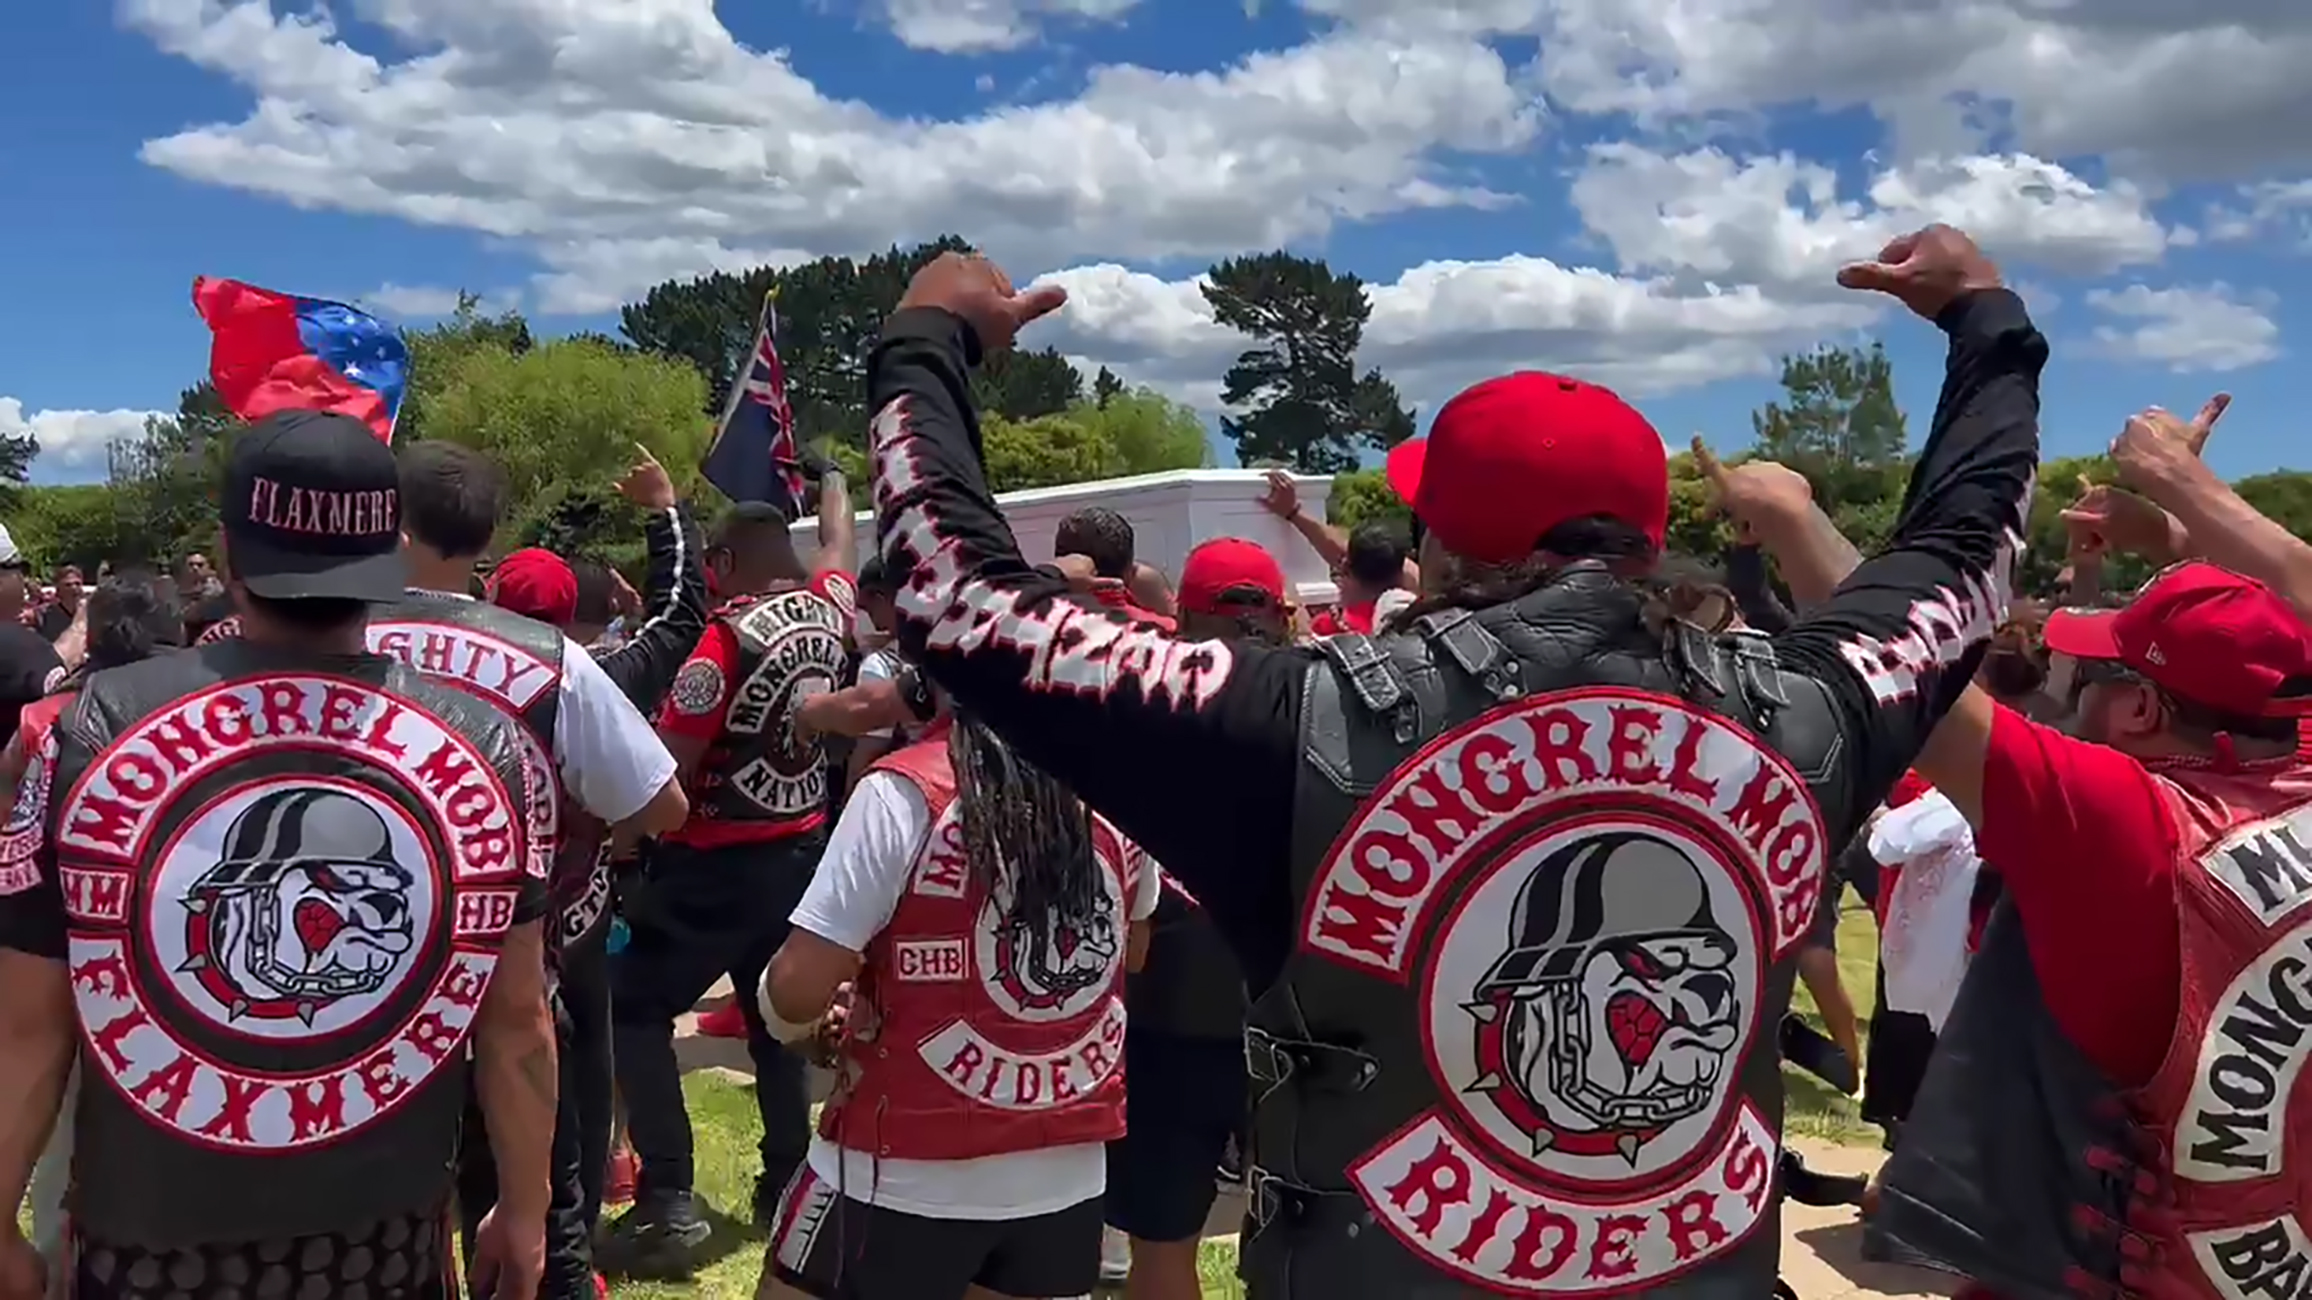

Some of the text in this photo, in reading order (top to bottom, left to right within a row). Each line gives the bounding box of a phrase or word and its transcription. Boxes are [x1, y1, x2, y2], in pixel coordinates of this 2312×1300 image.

[248, 475, 397, 537] FLAXMERE
[378, 632, 541, 696] GHTY
[70, 681, 511, 869] MONGREL MOB
[1315, 704, 1820, 963] MONGREL MOB
[460, 894, 512, 930] HB
[73, 950, 488, 1143] FLAXMERE
[943, 1014, 1123, 1105] RIDERS
[1384, 1127, 1772, 1281] RIDERS
